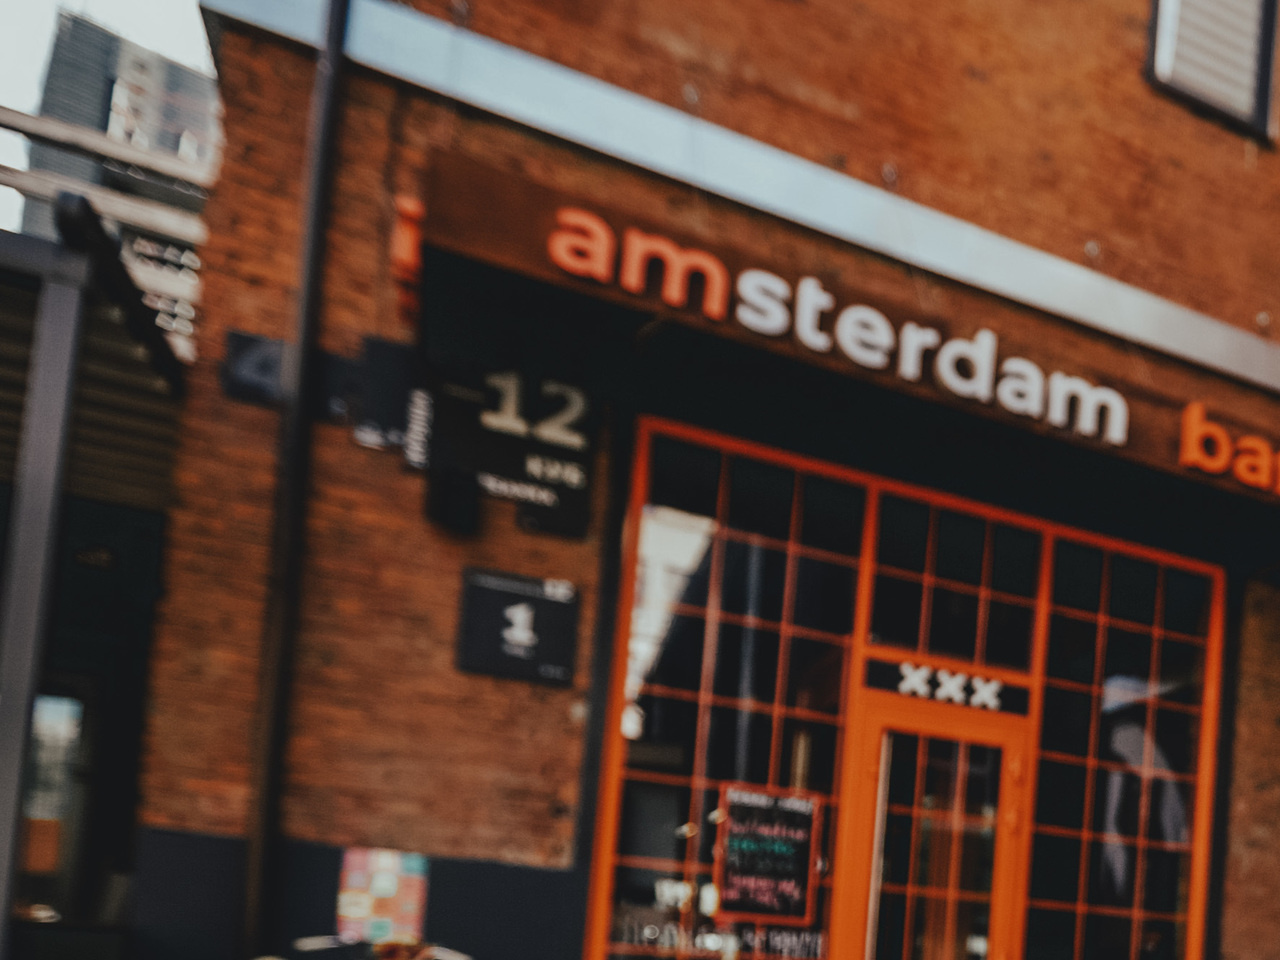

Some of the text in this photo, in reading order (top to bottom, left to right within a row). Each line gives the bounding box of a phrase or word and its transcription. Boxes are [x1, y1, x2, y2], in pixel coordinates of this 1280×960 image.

[547, 206, 1129, 446] amsterdam
[480, 373, 586, 450] 12
[502, 602, 538, 647] 1
